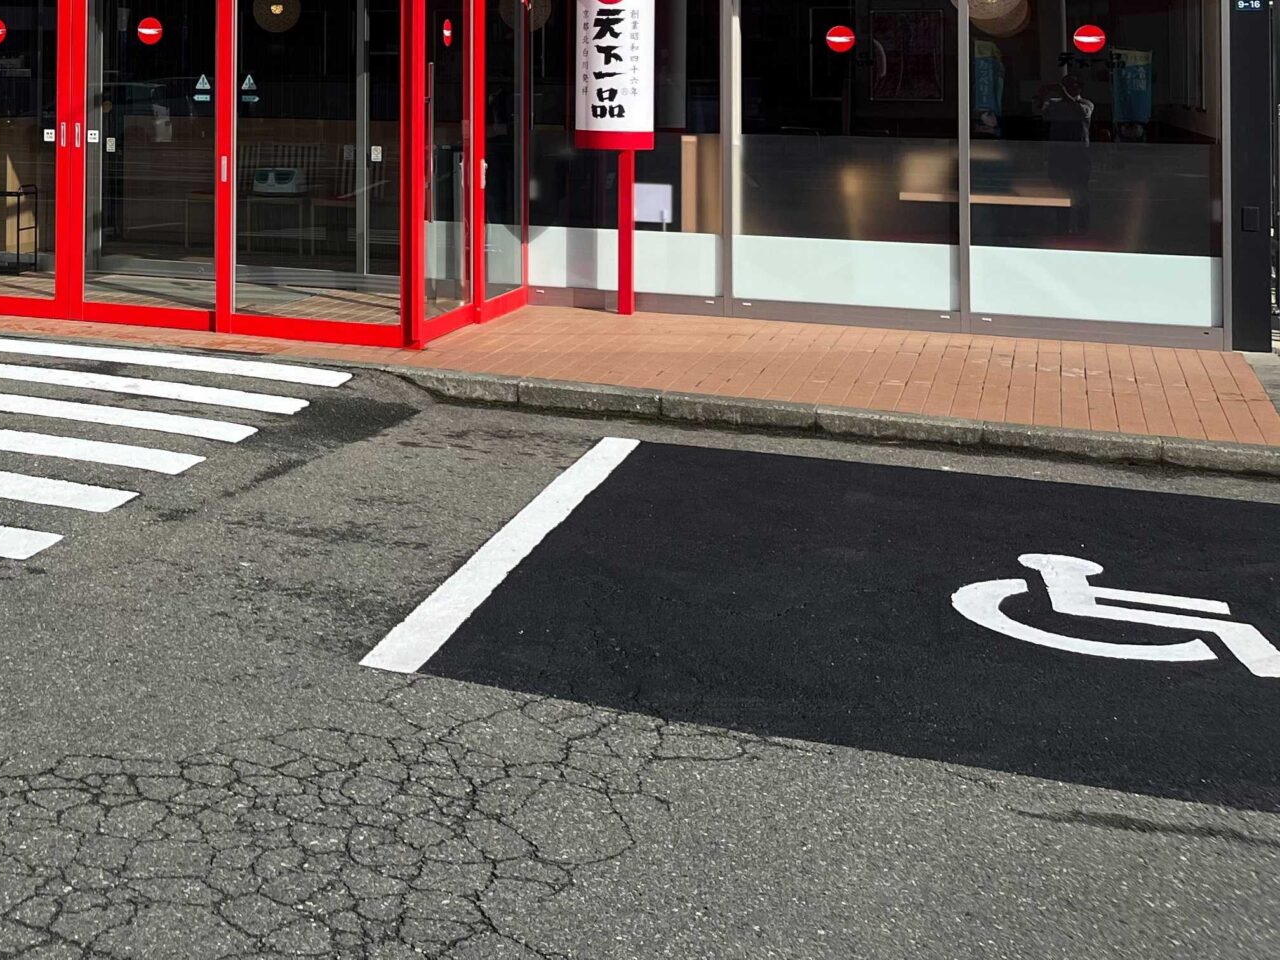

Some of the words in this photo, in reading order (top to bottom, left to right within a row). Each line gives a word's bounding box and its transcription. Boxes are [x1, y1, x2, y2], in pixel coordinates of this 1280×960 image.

[1238, 0, 1261, 9] 9-16
[591, 8, 627, 119] 天下一品
